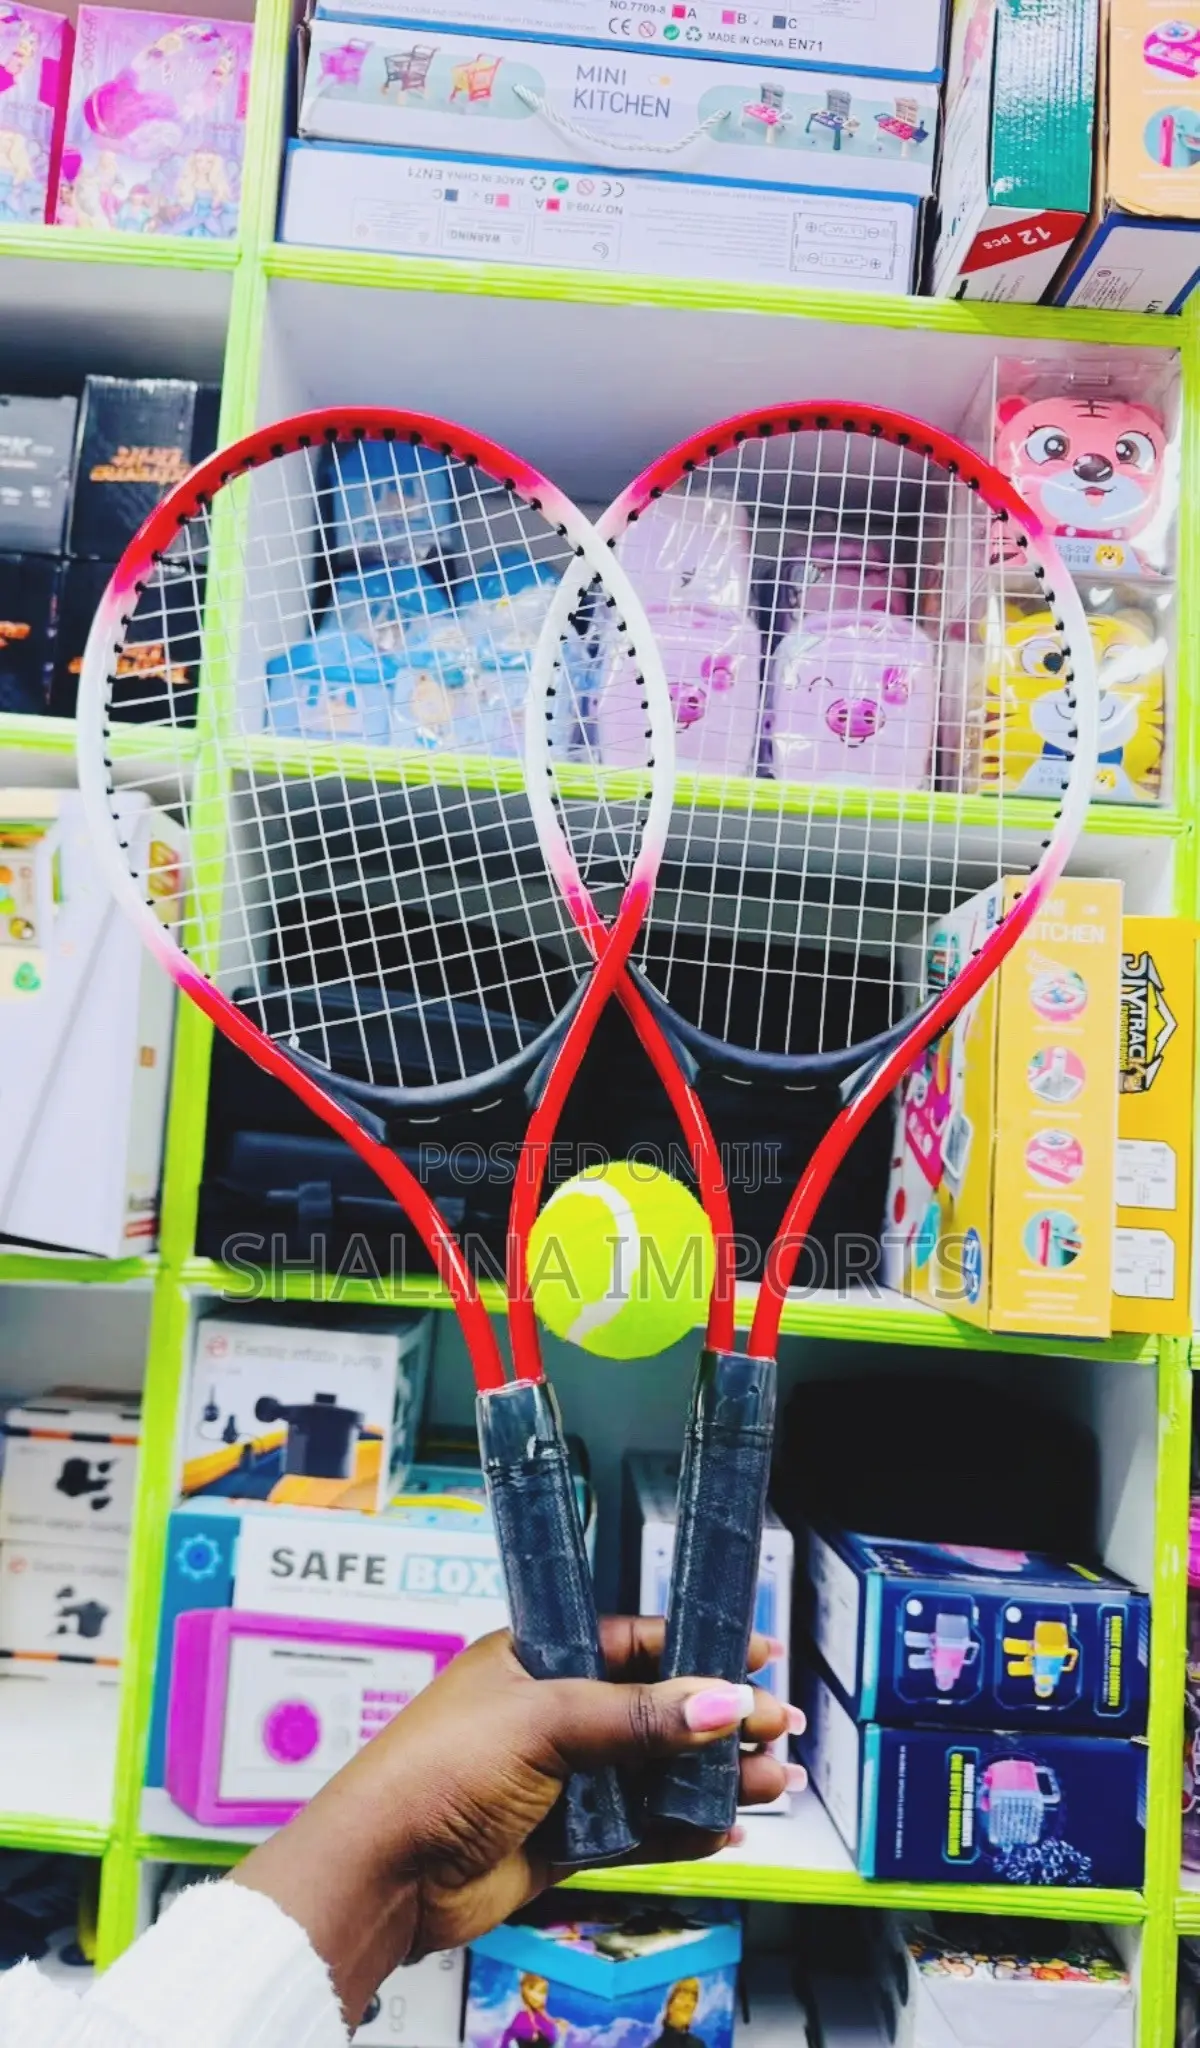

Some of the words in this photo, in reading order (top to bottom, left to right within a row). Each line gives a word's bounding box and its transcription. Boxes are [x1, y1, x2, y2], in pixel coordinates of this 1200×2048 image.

[687, 8, 697, 19] A
[707, 32, 736, 44] MADE
[740, 36, 749, 44] IN
[752, 37, 784, 47] CHINA
[788, 38, 822, 52] EN71
[576, 64, 627, 86] MINI
[573, 87, 671, 119] KITCHEN
[408, 165, 443, 181] EN71
[982, 234, 1012, 250] pcs
[1016, 226, 1052, 246] 12
[270, 1548, 387, 1586] SAFE
[404, 1555, 500, 1597] BOX
